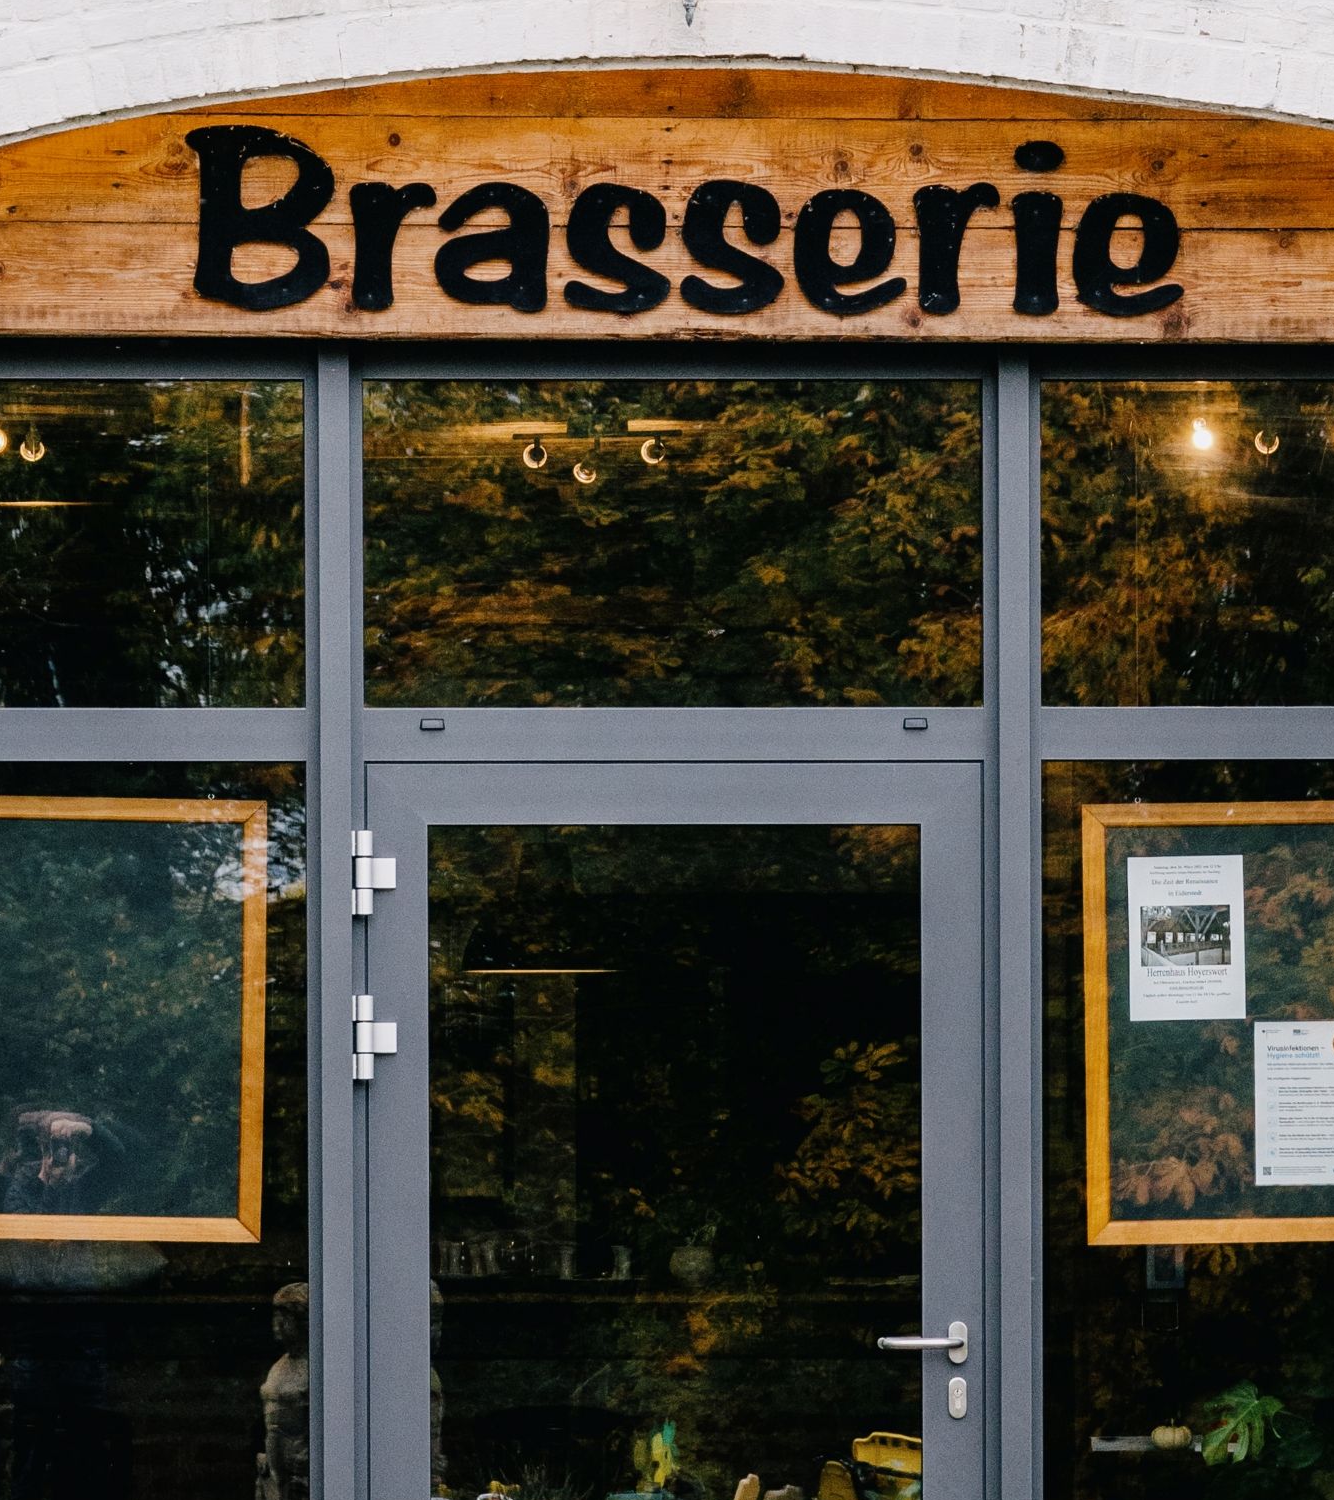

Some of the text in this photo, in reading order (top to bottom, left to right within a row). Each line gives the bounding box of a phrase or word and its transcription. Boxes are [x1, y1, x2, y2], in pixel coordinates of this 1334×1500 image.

[184, 124, 1185, 320] Brasserie
[1147, 967, 1228, 978] Herrenhaus Hoyerswort
[1267, 1052, 1293, 1060] Hygiene
